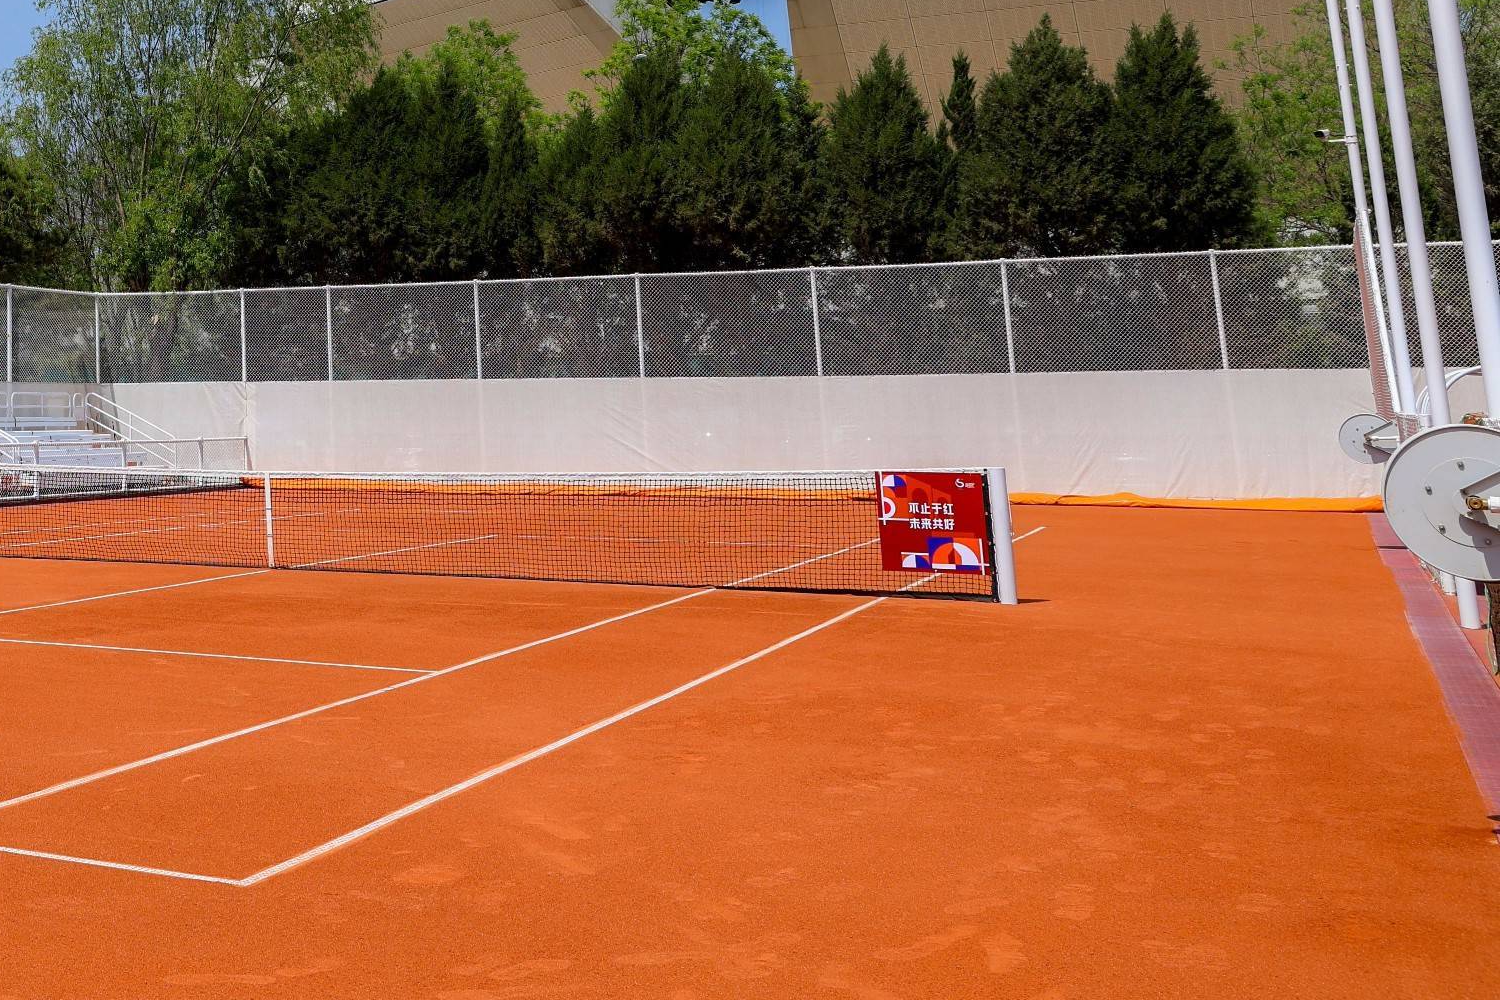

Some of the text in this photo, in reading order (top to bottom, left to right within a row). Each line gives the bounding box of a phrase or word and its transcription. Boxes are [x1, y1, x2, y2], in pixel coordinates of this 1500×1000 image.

[908, 502, 954, 515] 不止于红
[909, 518, 955, 531] 未来共好
